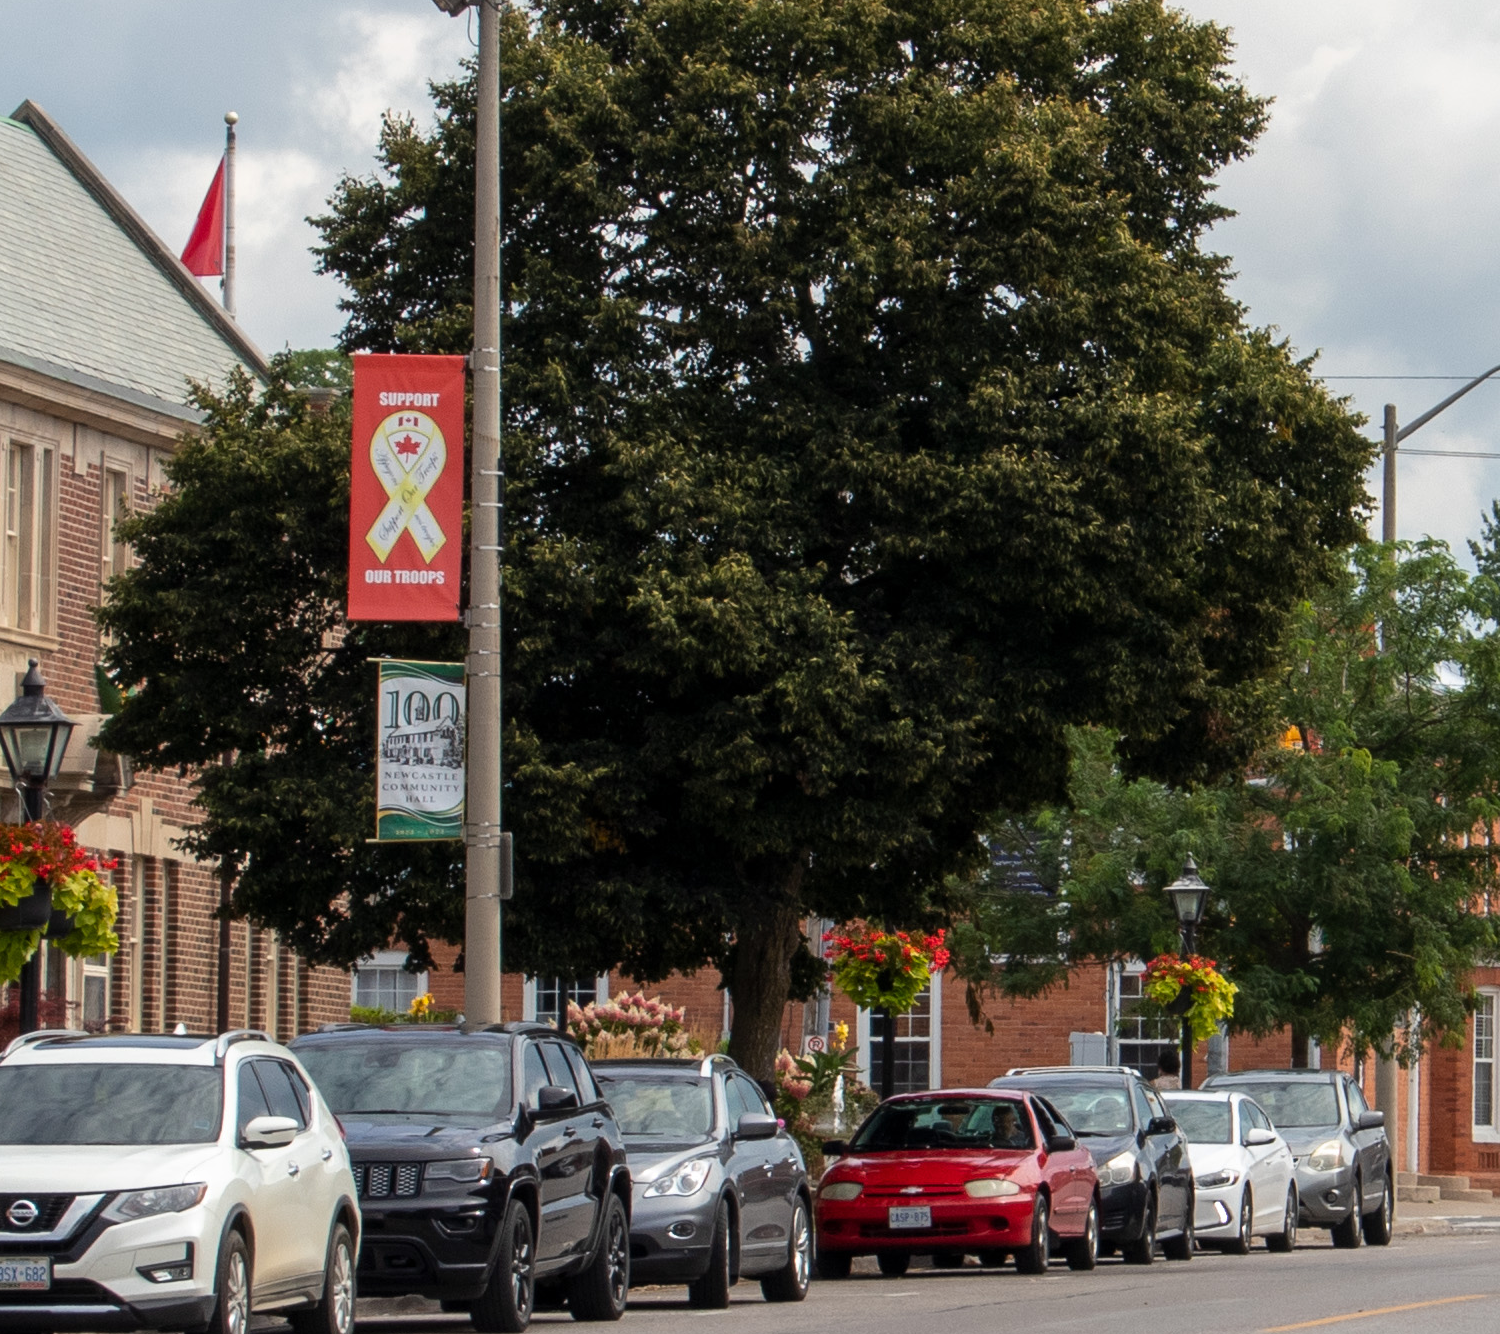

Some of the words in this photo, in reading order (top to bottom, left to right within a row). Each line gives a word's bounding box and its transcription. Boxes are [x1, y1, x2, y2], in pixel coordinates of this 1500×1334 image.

[379, 391, 440, 407] SUPPORT
[365, 569, 392, 584] OUR
[394, 570, 445, 585] TROOPS
[384, 690, 460, 729] 100
[384, 771, 458, 781] NEWCASTLE
[382, 783, 460, 793] COMMUNITY
[405, 795, 436, 804] HALL
[25, 1266, 46, 1281] 682
